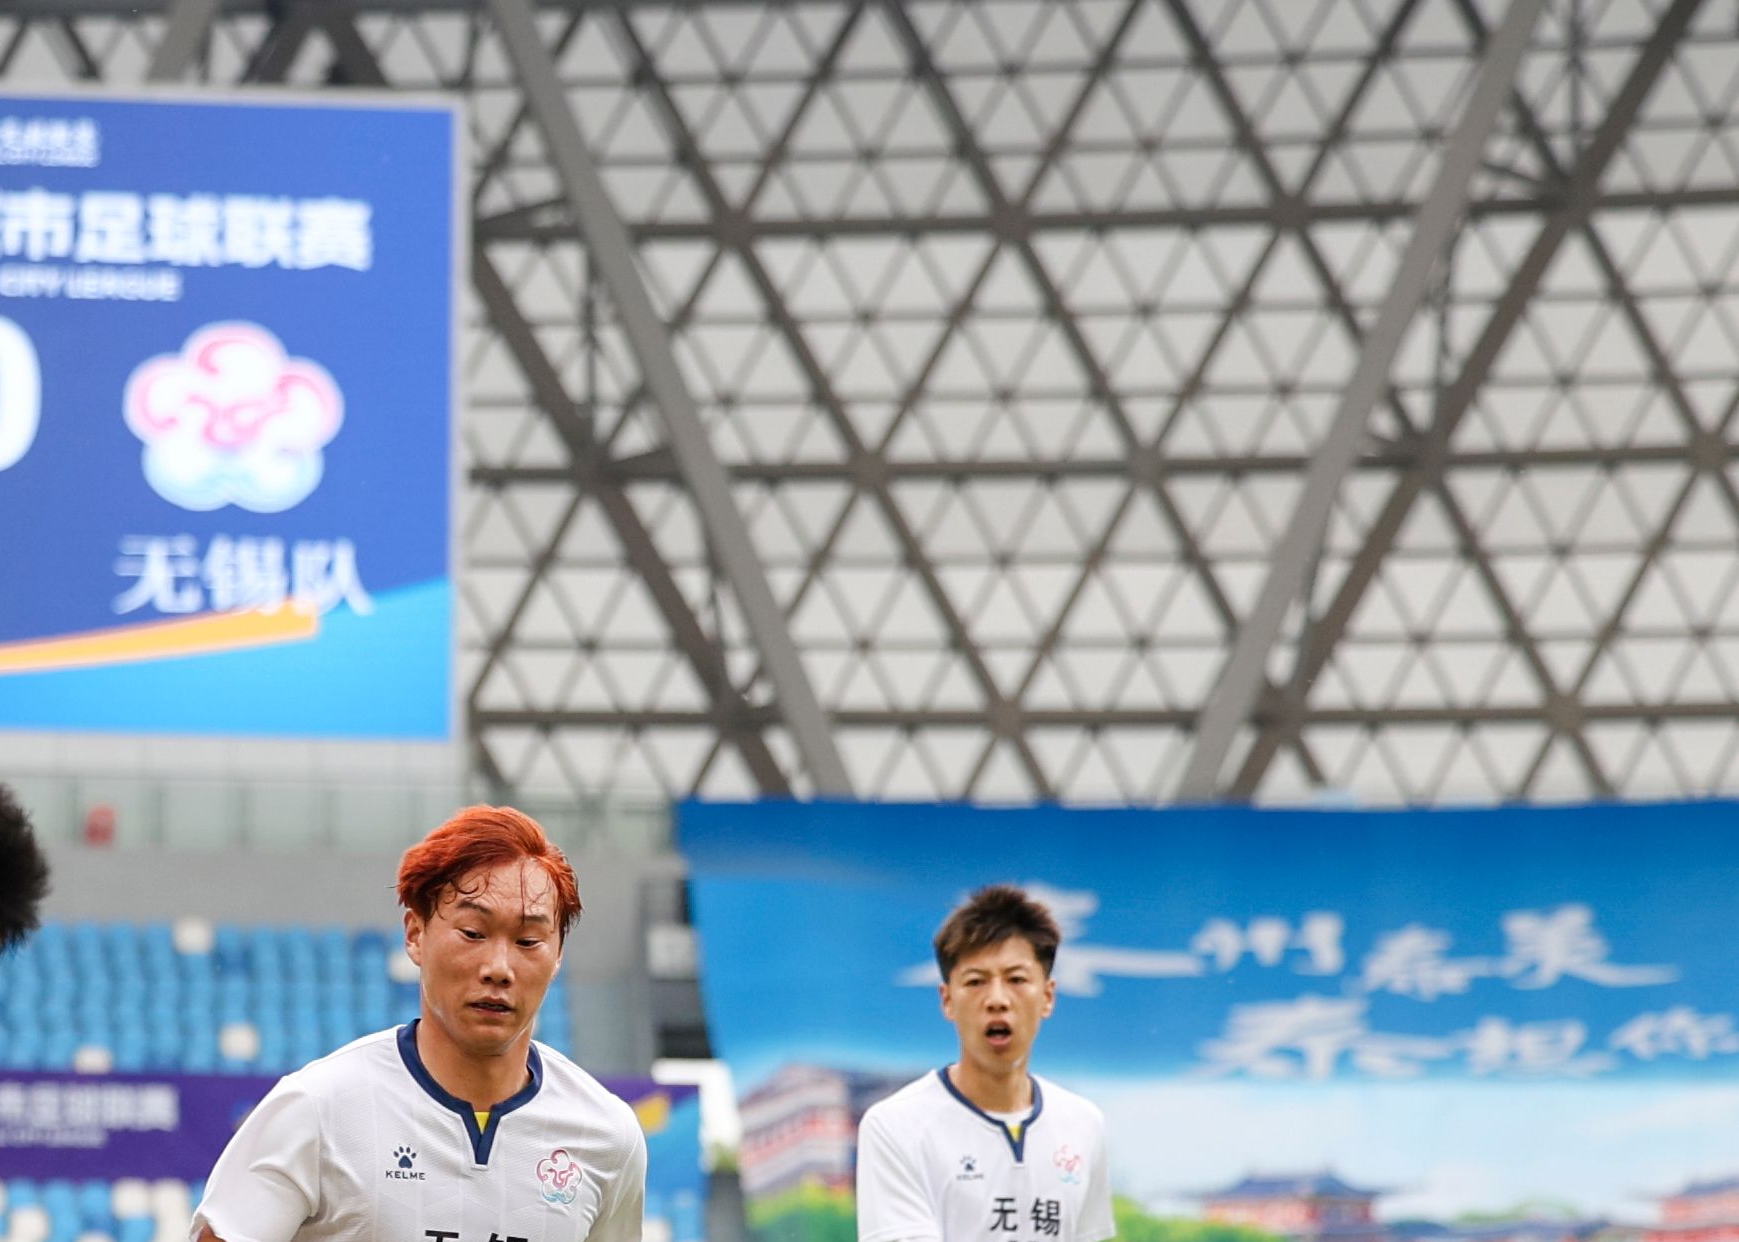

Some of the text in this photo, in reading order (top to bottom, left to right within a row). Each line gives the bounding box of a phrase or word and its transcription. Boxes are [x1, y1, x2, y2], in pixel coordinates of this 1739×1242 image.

[112, 533, 374, 616] 无锡队
[385, 1170, 426, 1181] KELME
[989, 1197, 1061, 1237] 无锡
